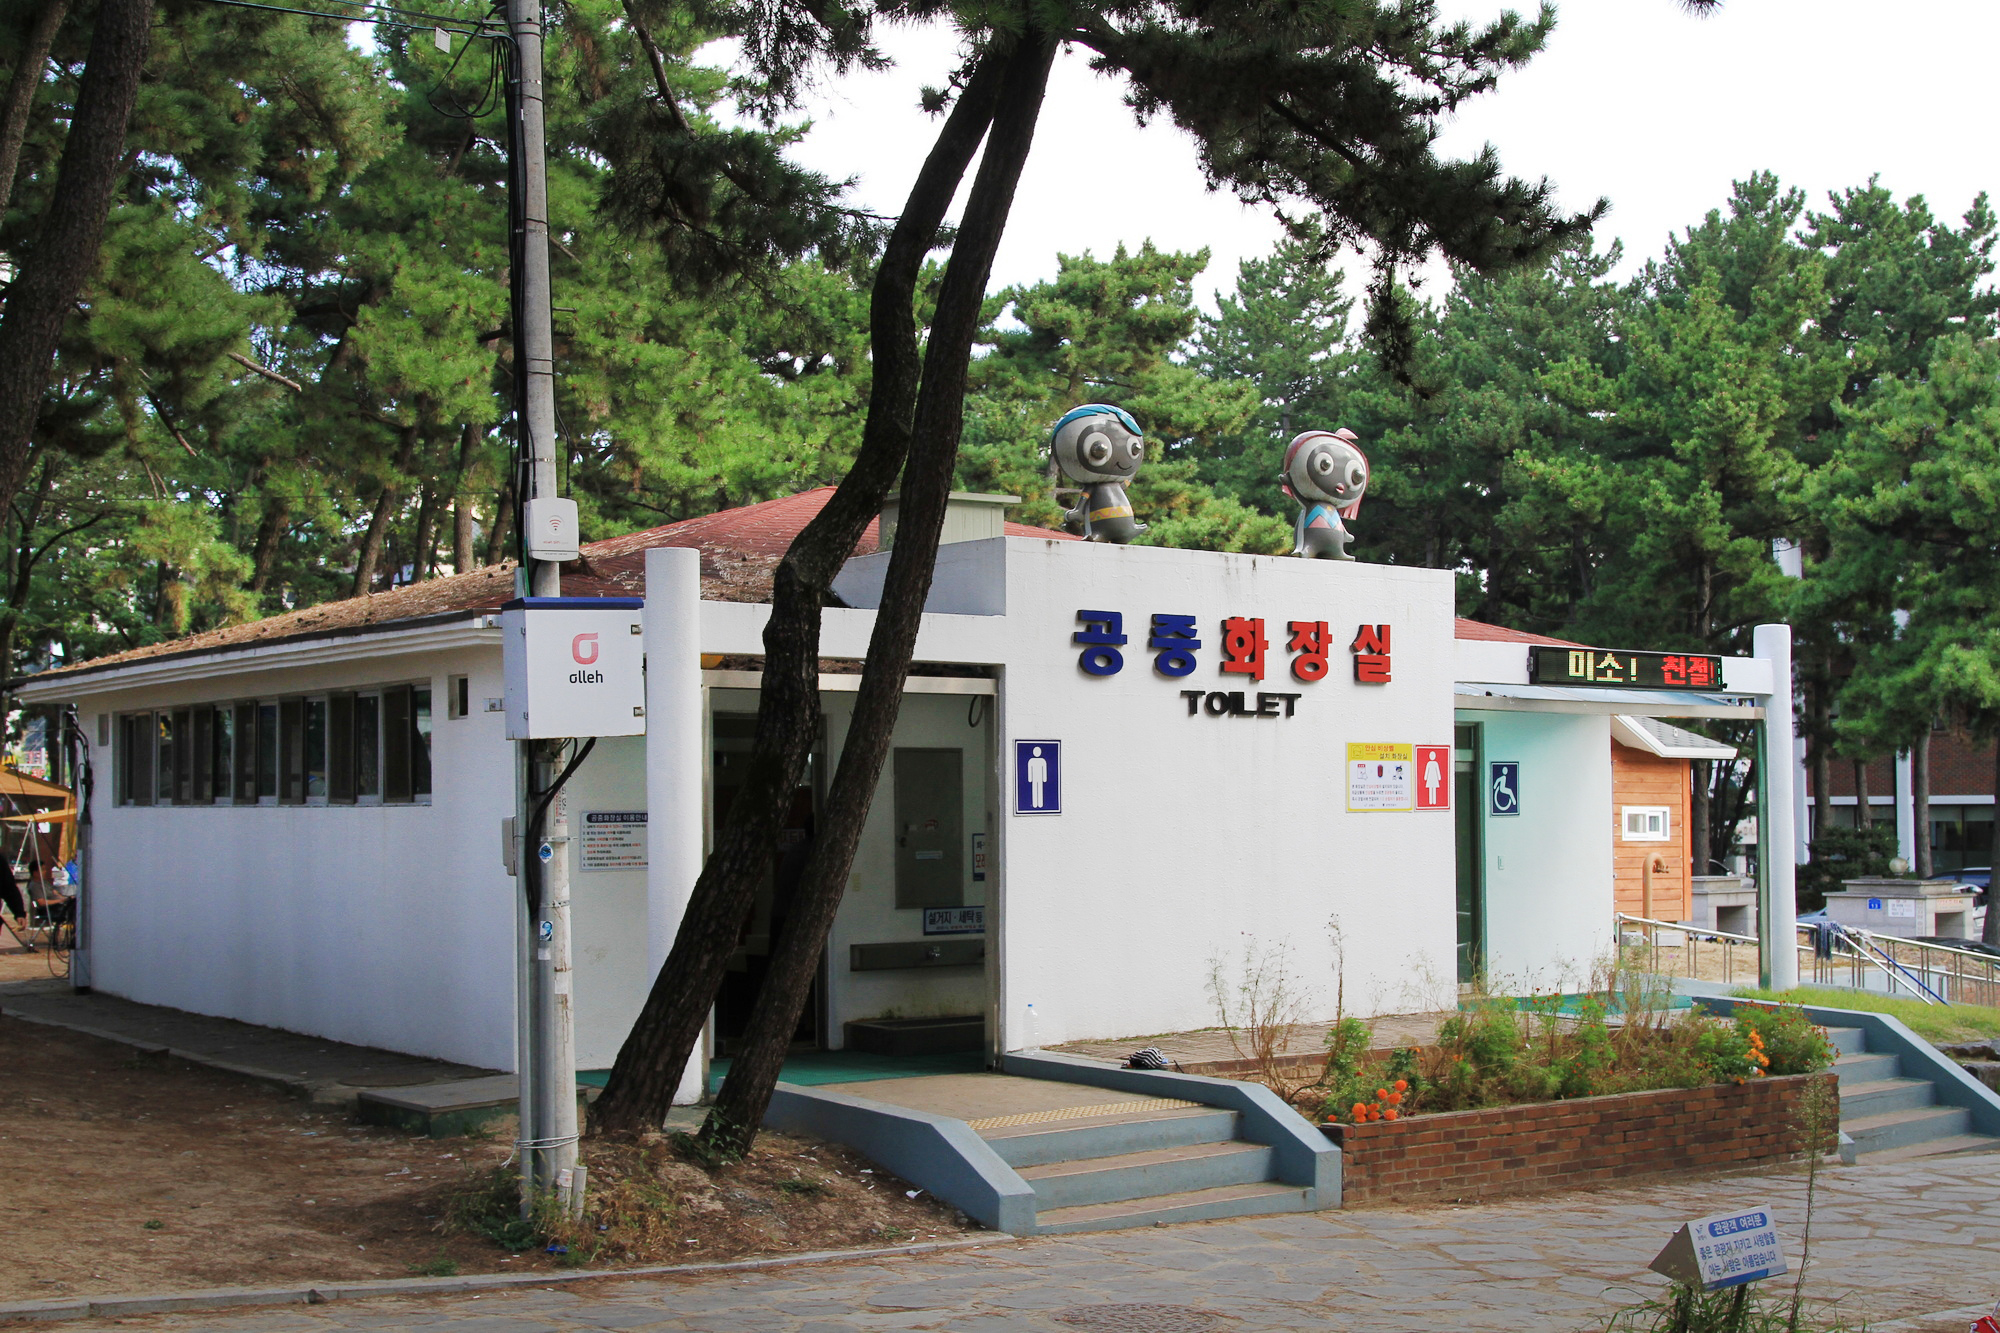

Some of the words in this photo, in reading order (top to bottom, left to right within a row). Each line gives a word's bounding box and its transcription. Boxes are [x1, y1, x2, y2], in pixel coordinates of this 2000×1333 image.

[1073, 609, 1392, 683] 공중화장실
[569, 670, 604, 684] olleh
[1568, 650, 1638, 683] 미소!
[1661, 655, 1715, 686] 친절!
[1180, 690, 1302, 717] TOILET
[1365, 744, 1376, 752] 안심
[928, 911, 952, 925] 설거지
[1713, 1219, 1738, 1235] 관광객
[1740, 1214, 1762, 1228] 여러분
[1699, 1245, 1713, 1260] 좋은
